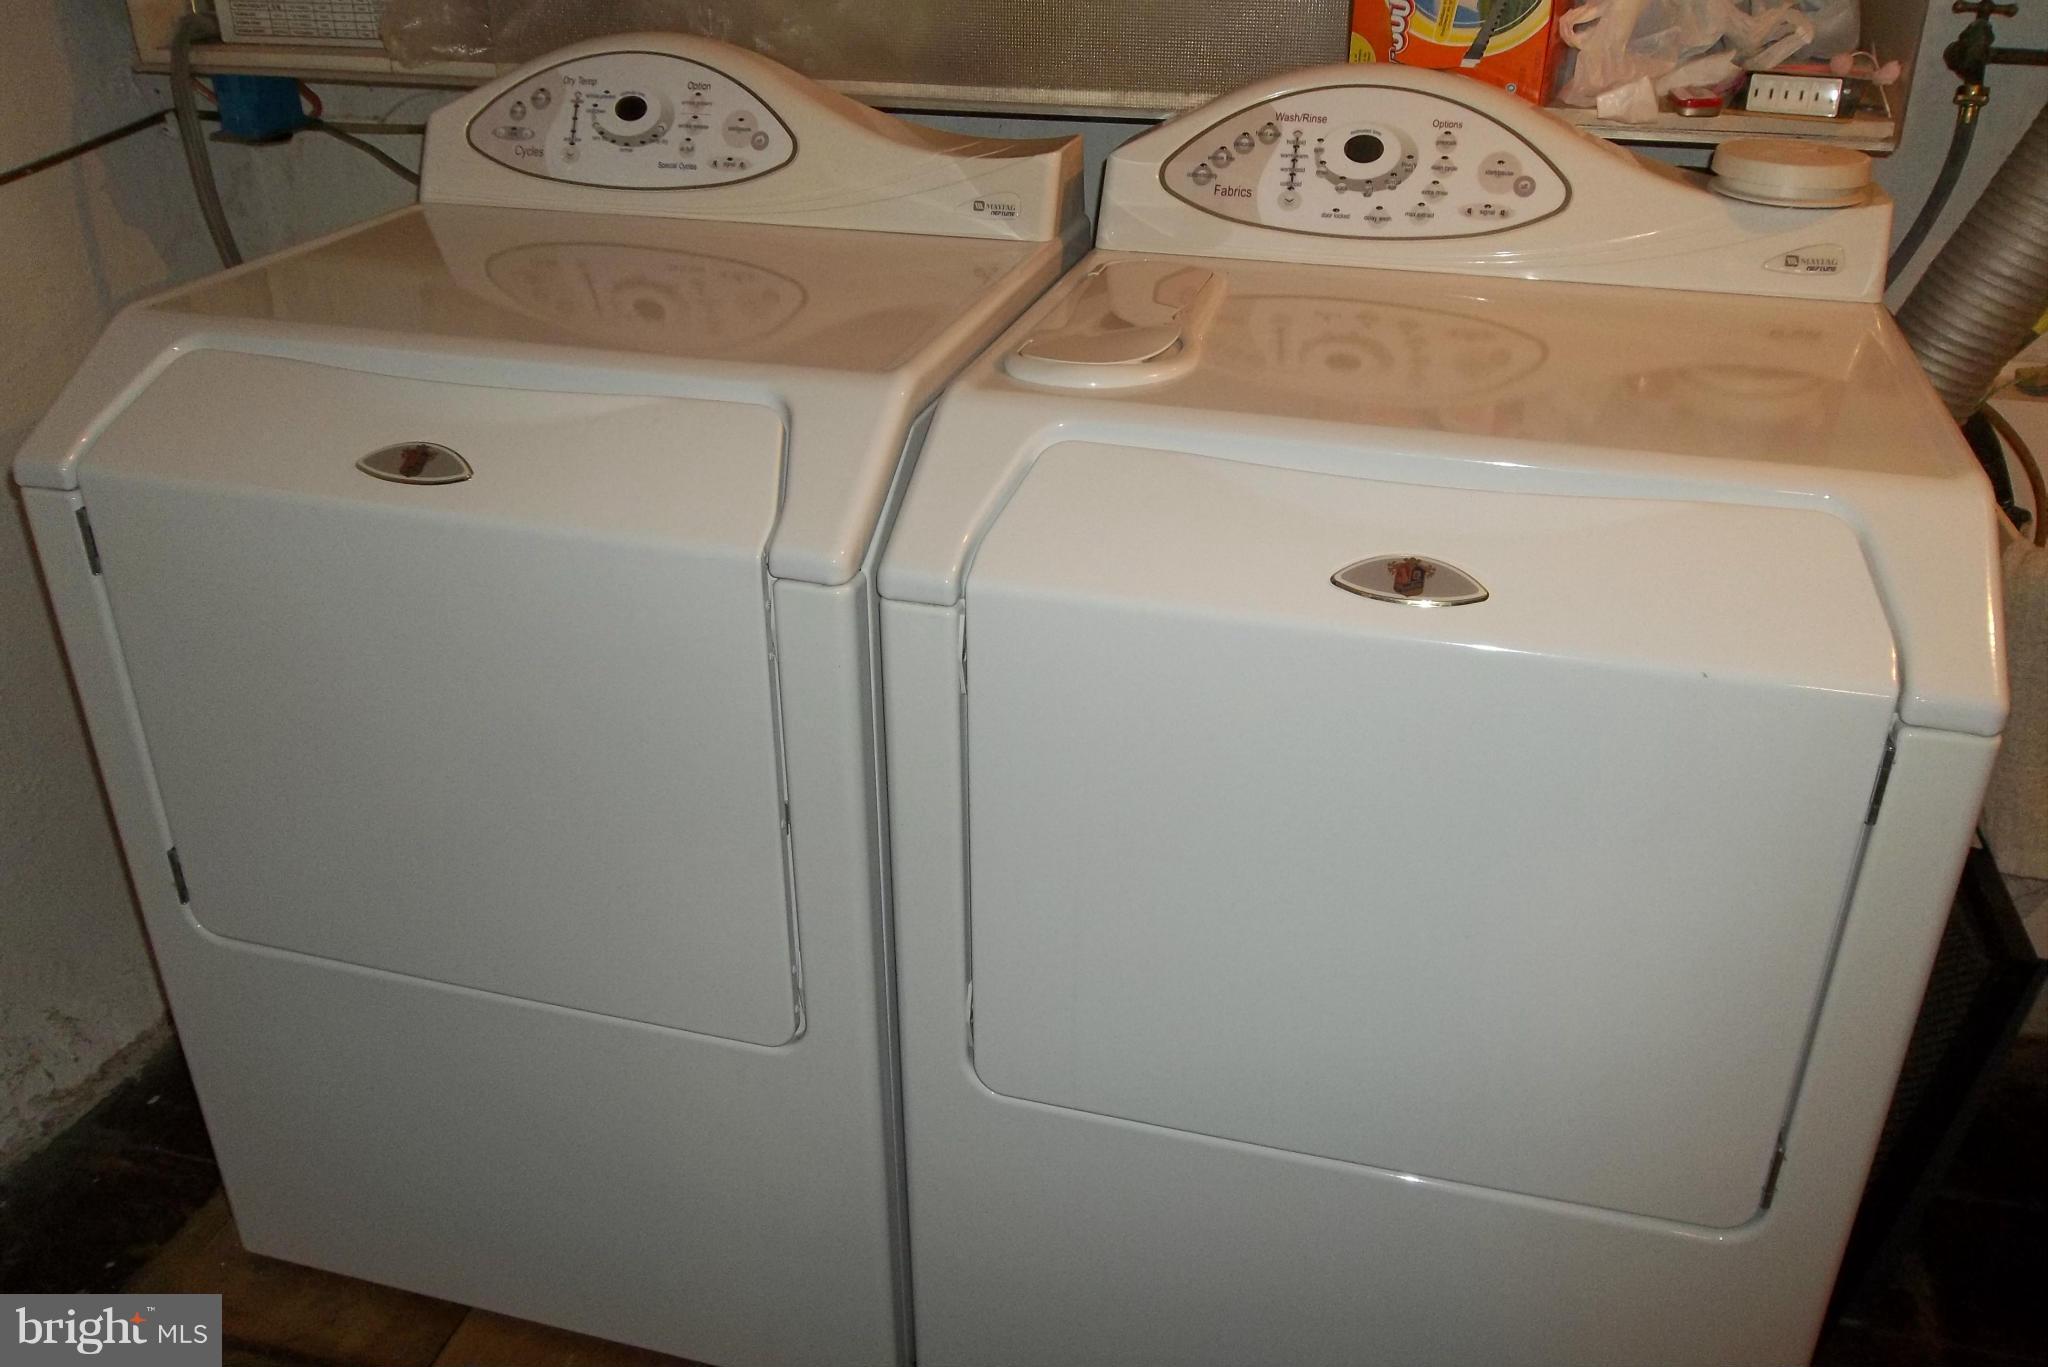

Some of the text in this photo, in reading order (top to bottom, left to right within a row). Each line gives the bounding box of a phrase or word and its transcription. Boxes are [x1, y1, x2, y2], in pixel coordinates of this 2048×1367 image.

[687, 81, 711, 91] Option
[1275, 112, 1328, 124] Wash/Rinse
[1432, 119, 1463, 129] Options
[514, 145, 544, 158] Cycles
[1214, 184, 1252, 198] Fabrics
